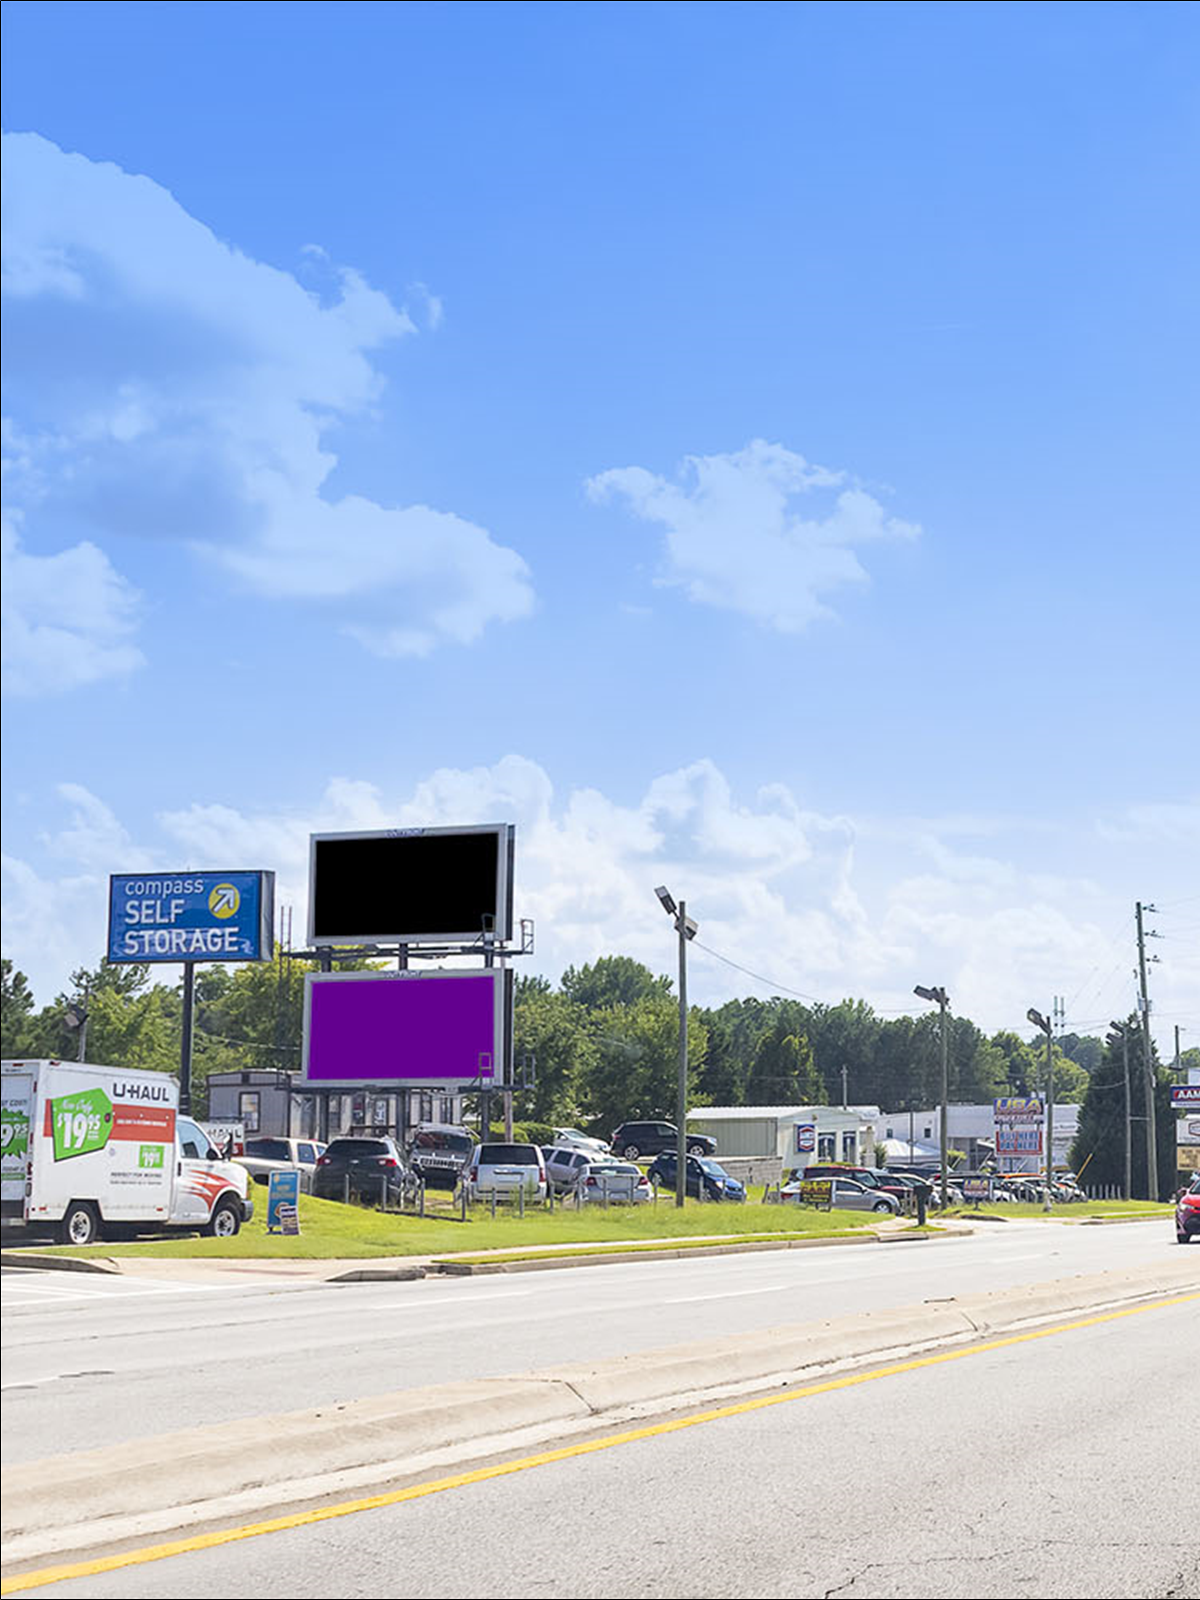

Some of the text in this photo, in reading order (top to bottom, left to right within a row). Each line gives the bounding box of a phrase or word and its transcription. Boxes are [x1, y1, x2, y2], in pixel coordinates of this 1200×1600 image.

[125, 879, 204, 898] compass
[124, 899, 185, 924] SELF
[124, 927, 239, 955] STORAGE
[113, 1082, 169, 1101] U-HAUL
[996, 1098, 1042, 1113] USA
